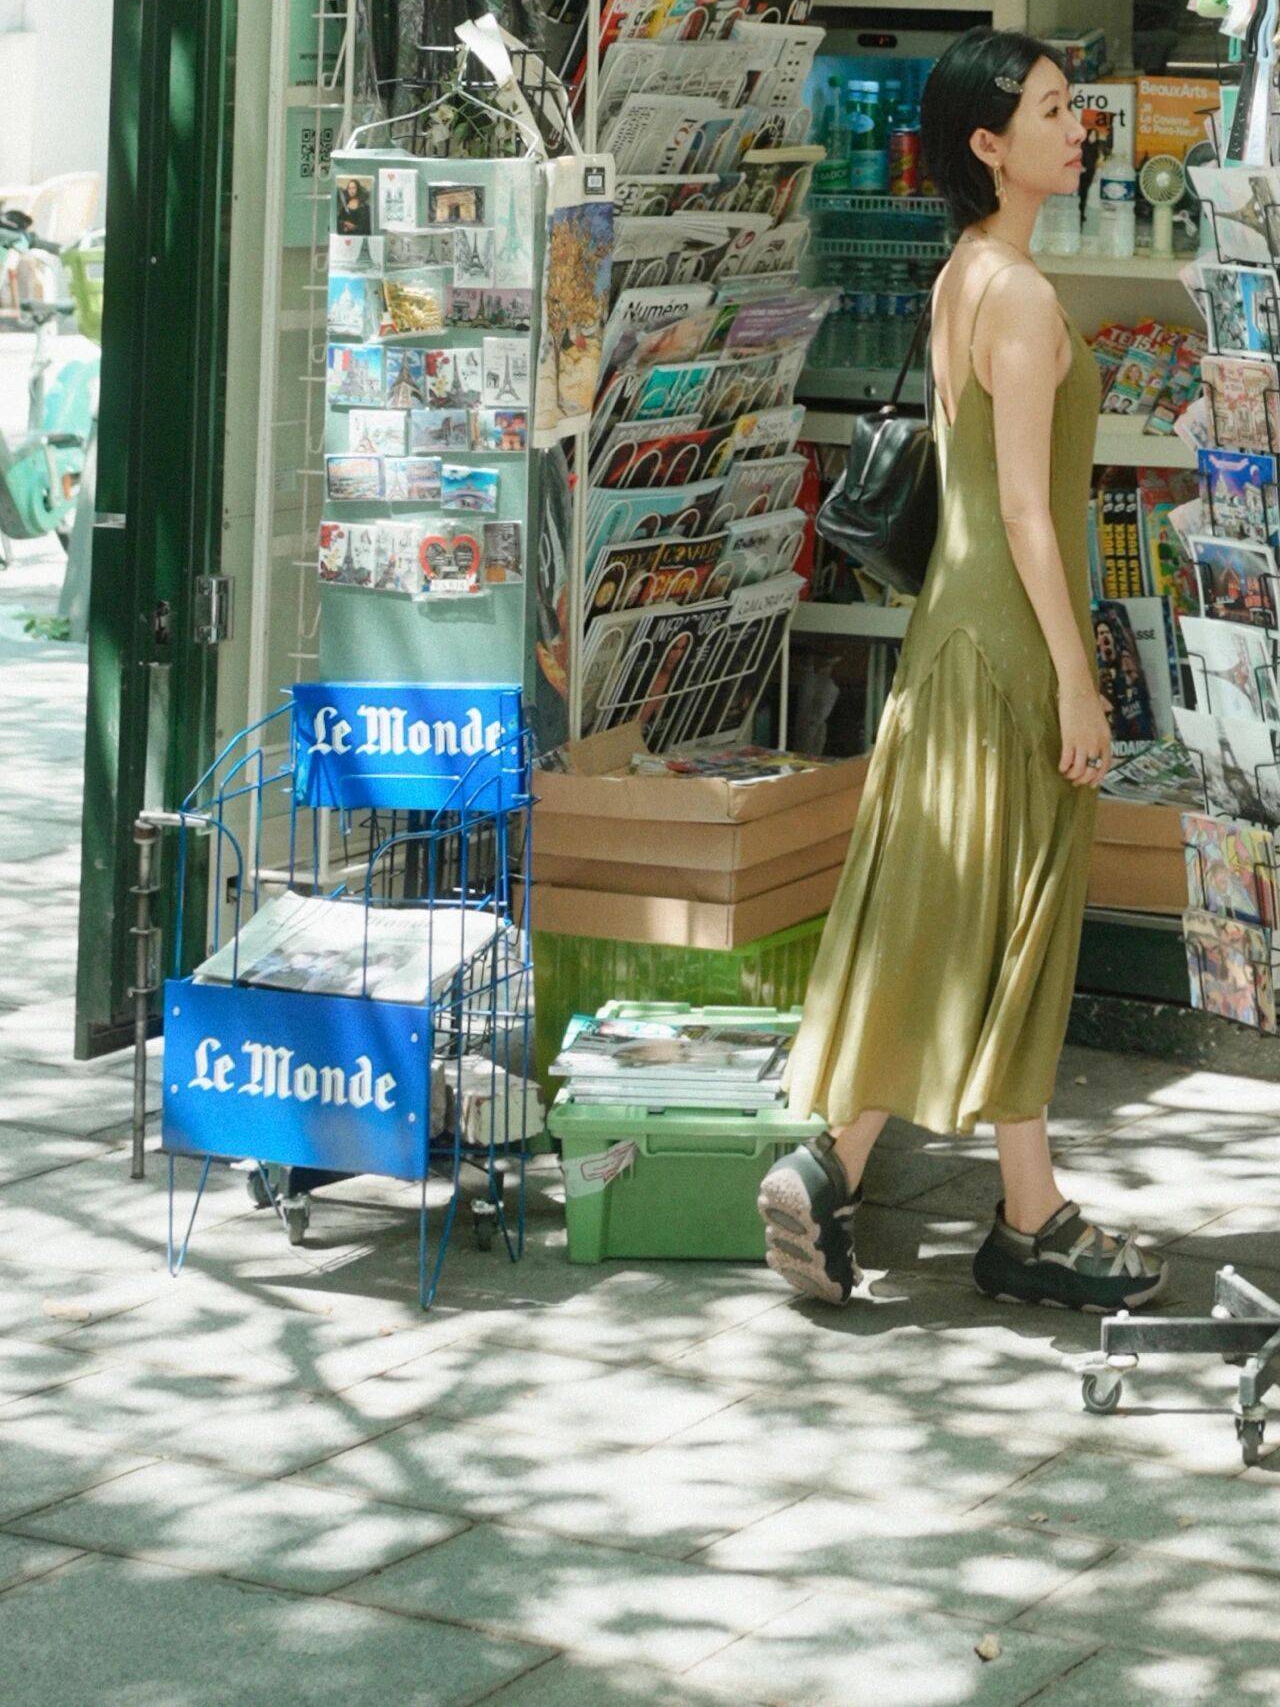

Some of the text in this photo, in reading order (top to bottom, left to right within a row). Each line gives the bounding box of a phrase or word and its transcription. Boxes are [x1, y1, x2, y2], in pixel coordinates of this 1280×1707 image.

[1068, 89, 1108, 110] éro
[307, 704, 508, 759] Le Monde
[188, 1036, 398, 1112] Le Monde
